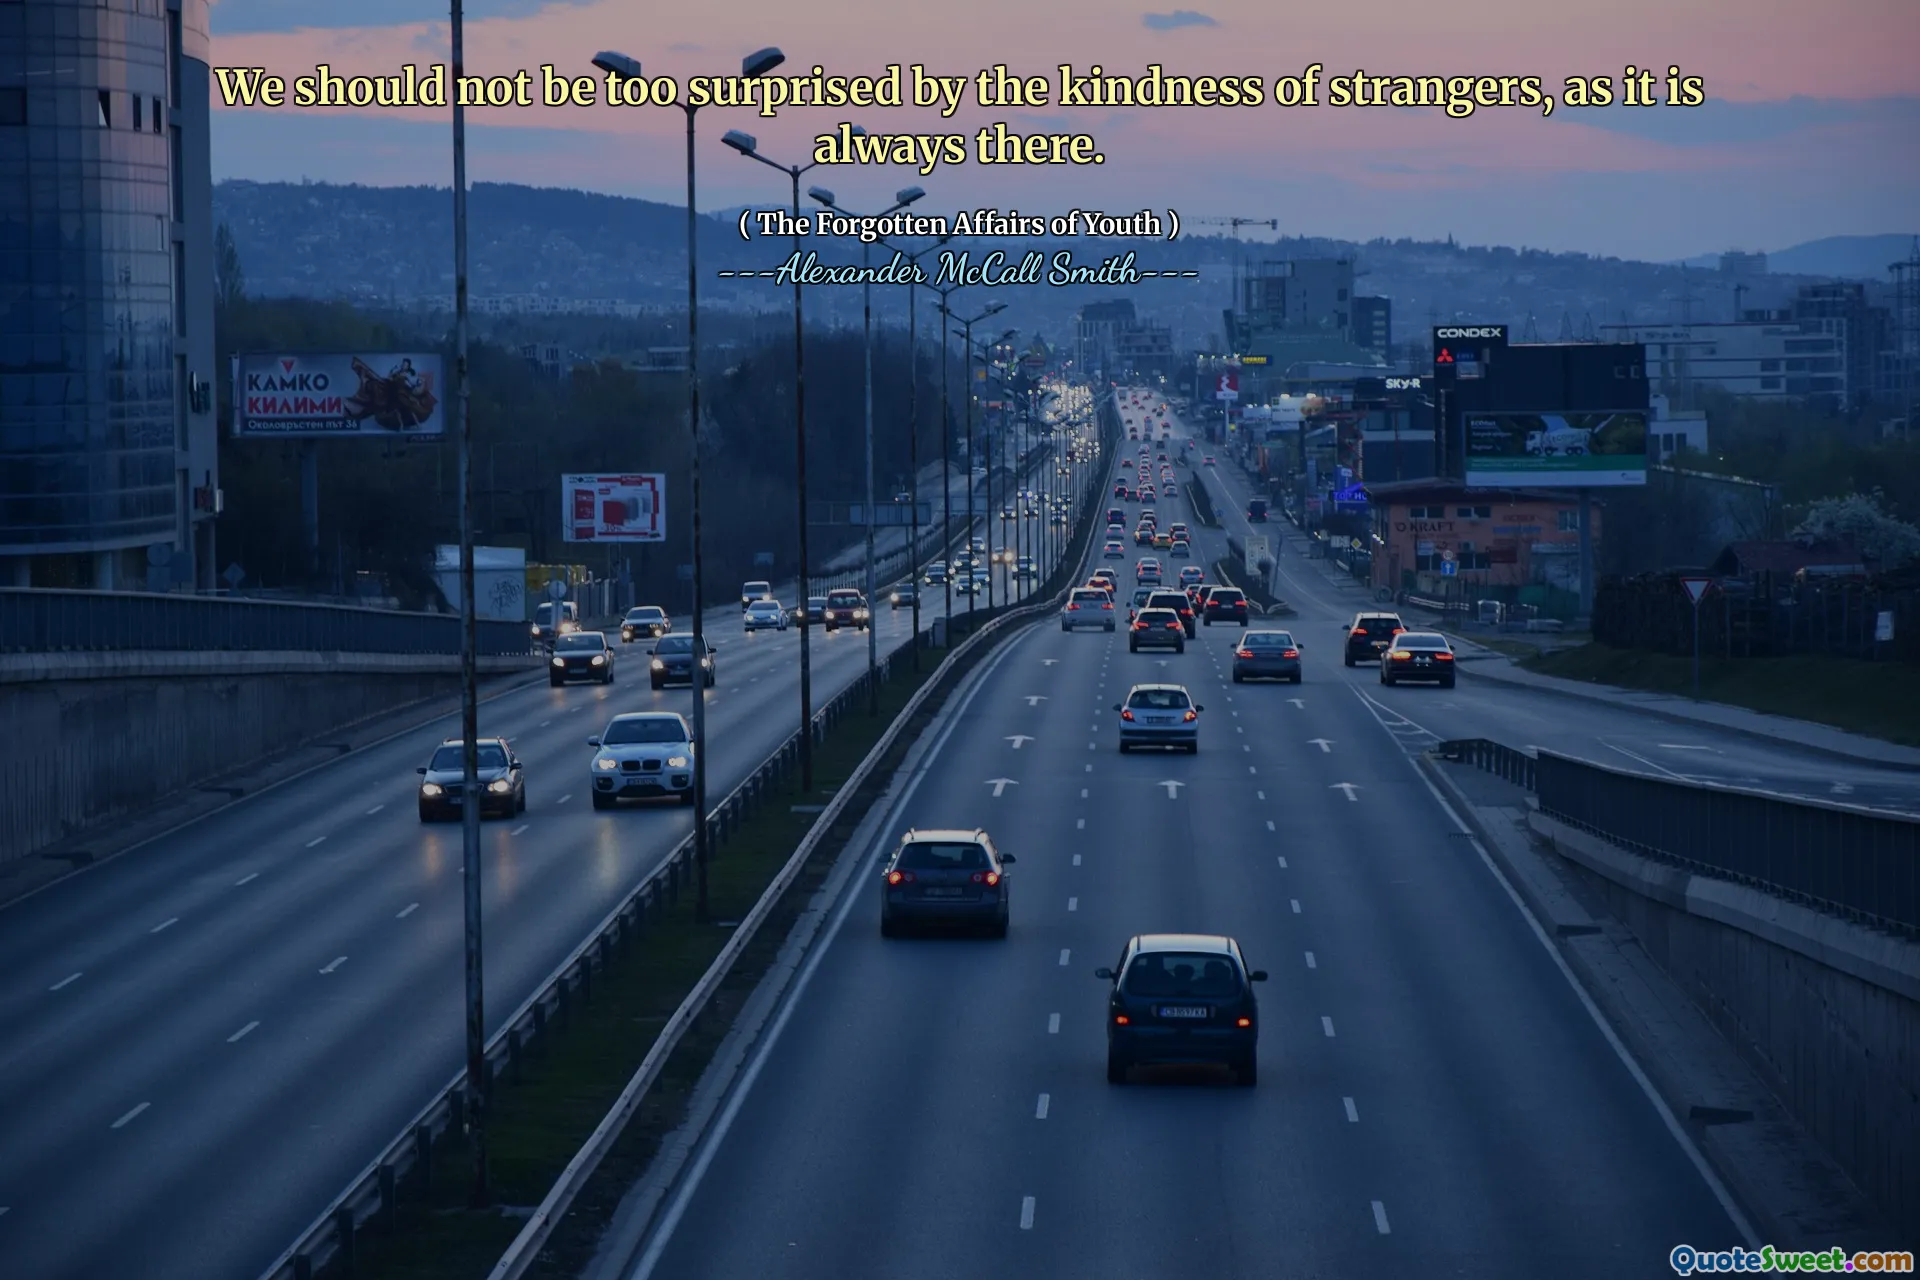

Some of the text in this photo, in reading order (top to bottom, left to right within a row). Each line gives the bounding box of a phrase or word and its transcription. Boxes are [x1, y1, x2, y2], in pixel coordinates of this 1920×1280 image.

[1437, 327, 1502, 338] CONDEX
[248, 373, 330, 391] КАМКО
[248, 397, 342, 414] КИЛИМИ
[248, 419, 324, 431] Околовръстен
[1410, 521, 1455, 532] KRAFT
